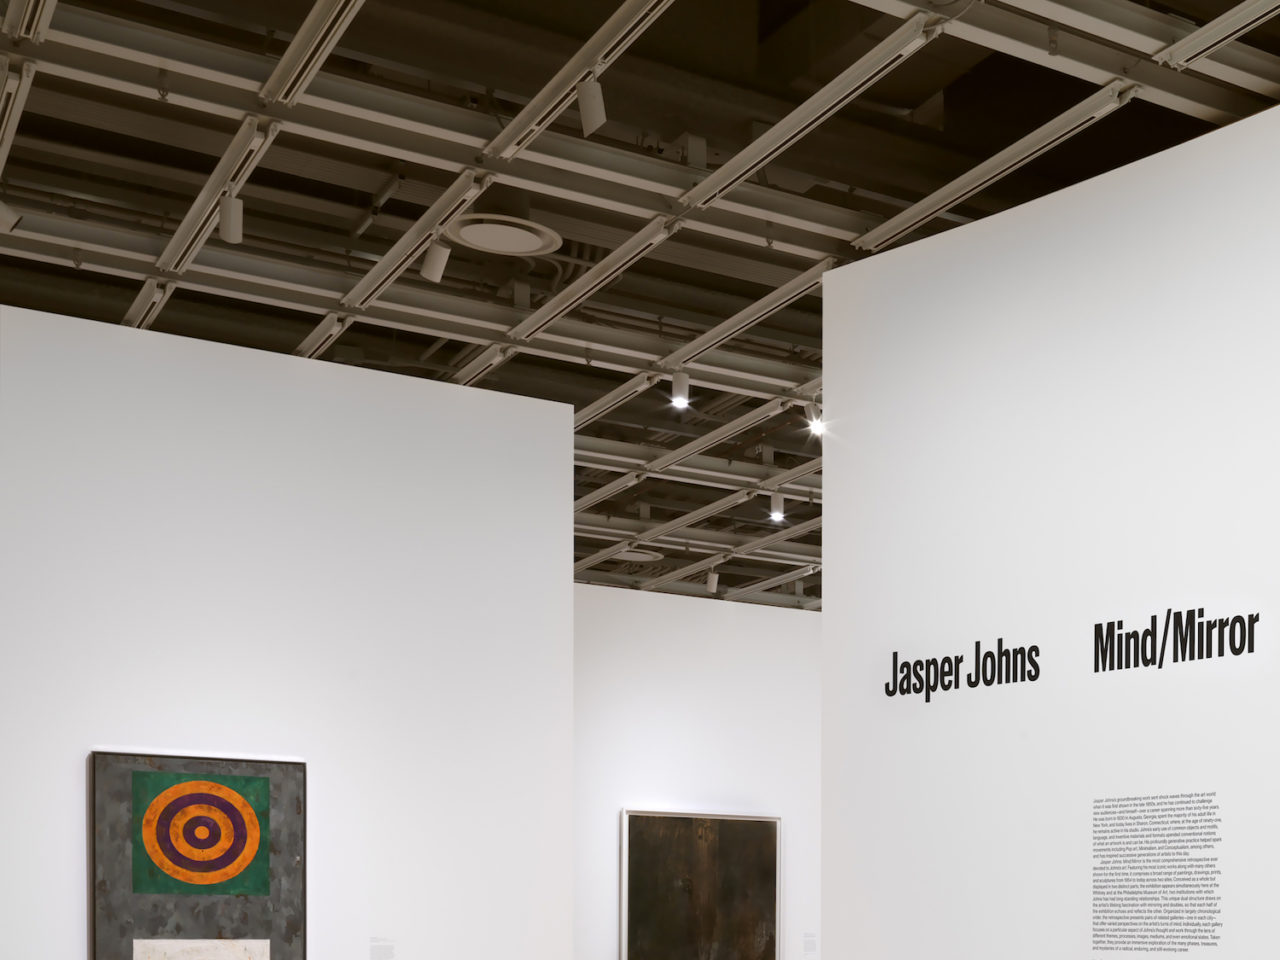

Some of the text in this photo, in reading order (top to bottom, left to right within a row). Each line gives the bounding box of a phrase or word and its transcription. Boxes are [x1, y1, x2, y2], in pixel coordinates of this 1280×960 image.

[884, 637, 1041, 704] Jasper Johns
[1093, 607, 1260, 674] Mind/Mirror
